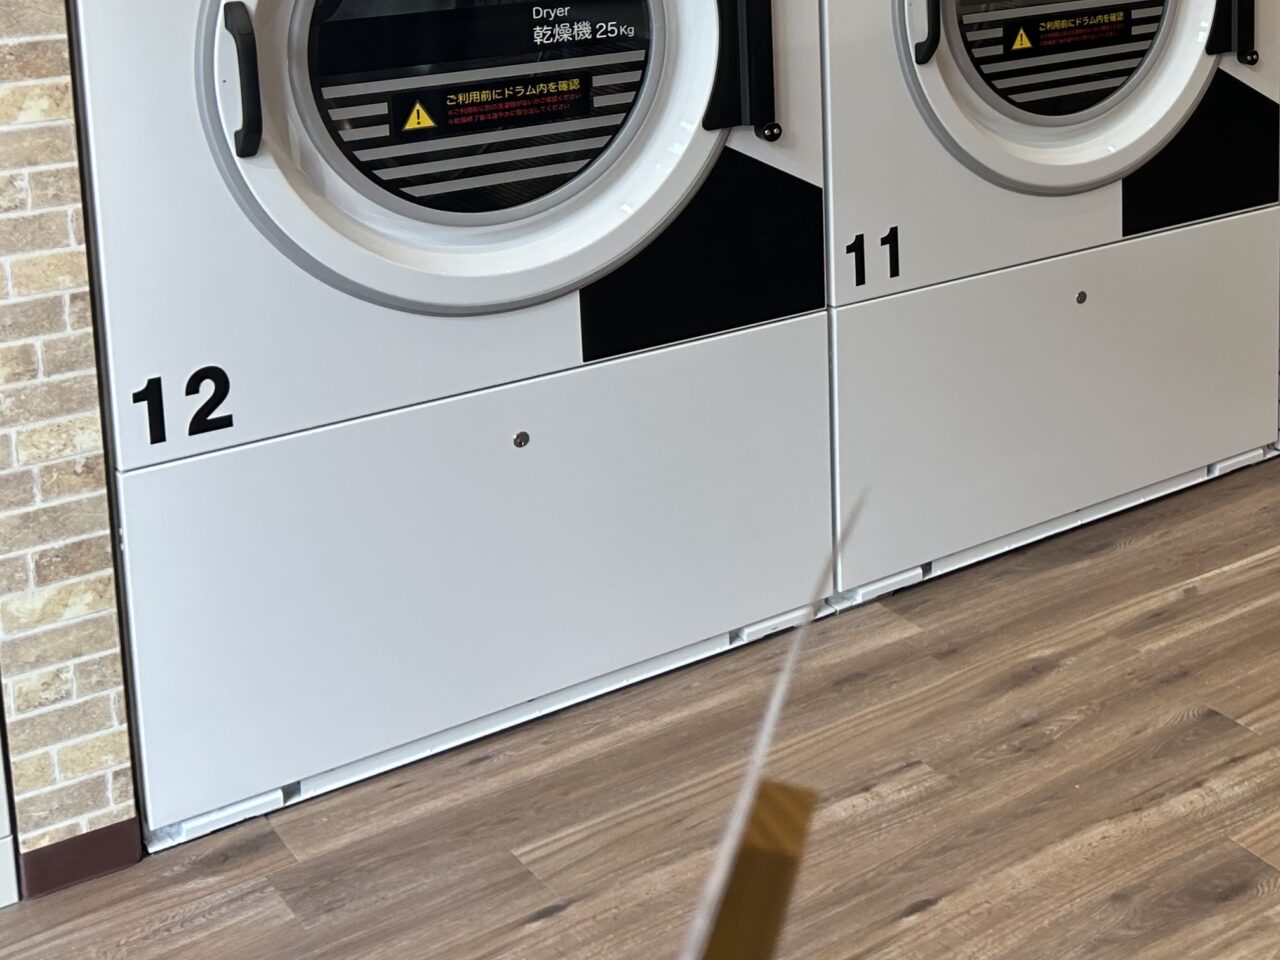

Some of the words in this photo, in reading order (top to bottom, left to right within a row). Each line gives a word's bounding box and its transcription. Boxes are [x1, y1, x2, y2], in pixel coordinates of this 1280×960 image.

[532, 5, 570, 23] Dryer
[533, 21, 592, 45] 乾燥機
[595, 22, 635, 39] 25Kg
[446, 78, 581, 106] ご利用前にドラム内を確認
[846, 225, 900, 287] 11
[132, 365, 234, 445] 12
